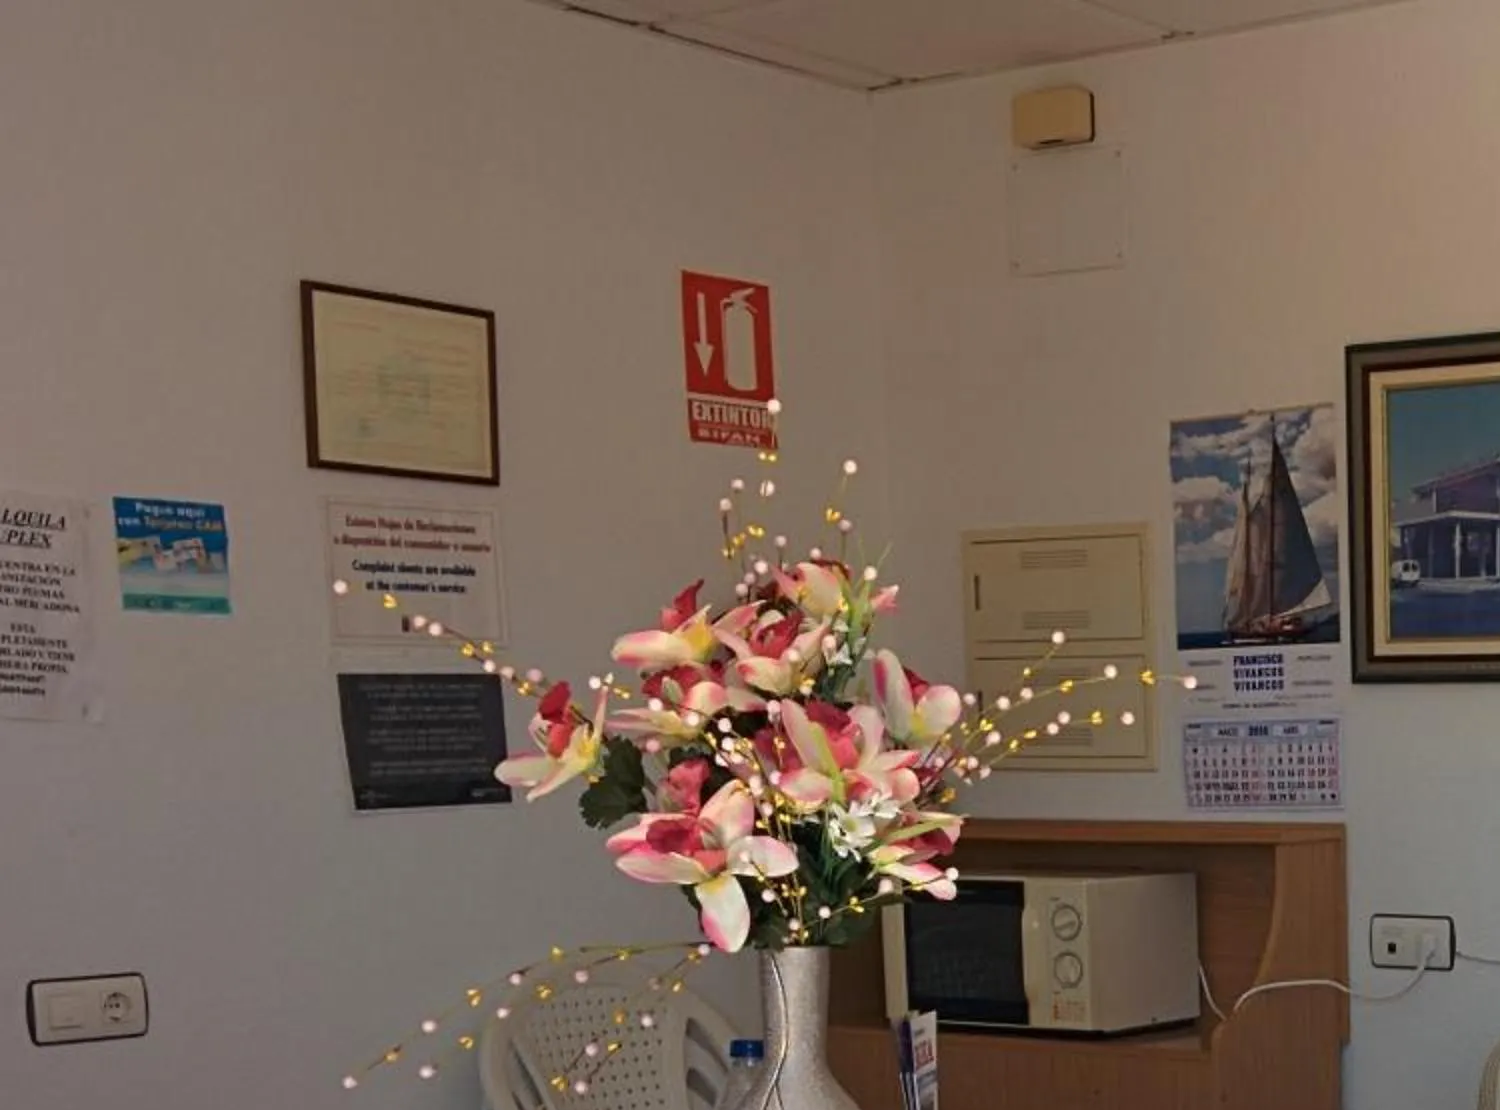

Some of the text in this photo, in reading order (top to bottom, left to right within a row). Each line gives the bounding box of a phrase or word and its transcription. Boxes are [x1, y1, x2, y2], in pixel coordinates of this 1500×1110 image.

[0, 560, 43, 573] ENTRA
[376, 580, 390, 591] the
[1233, 653, 1284, 667] FRANCISCO
[1233, 667, 1284, 679] VIVANCOS
[1233, 679, 1284, 692] VIVANCOS
